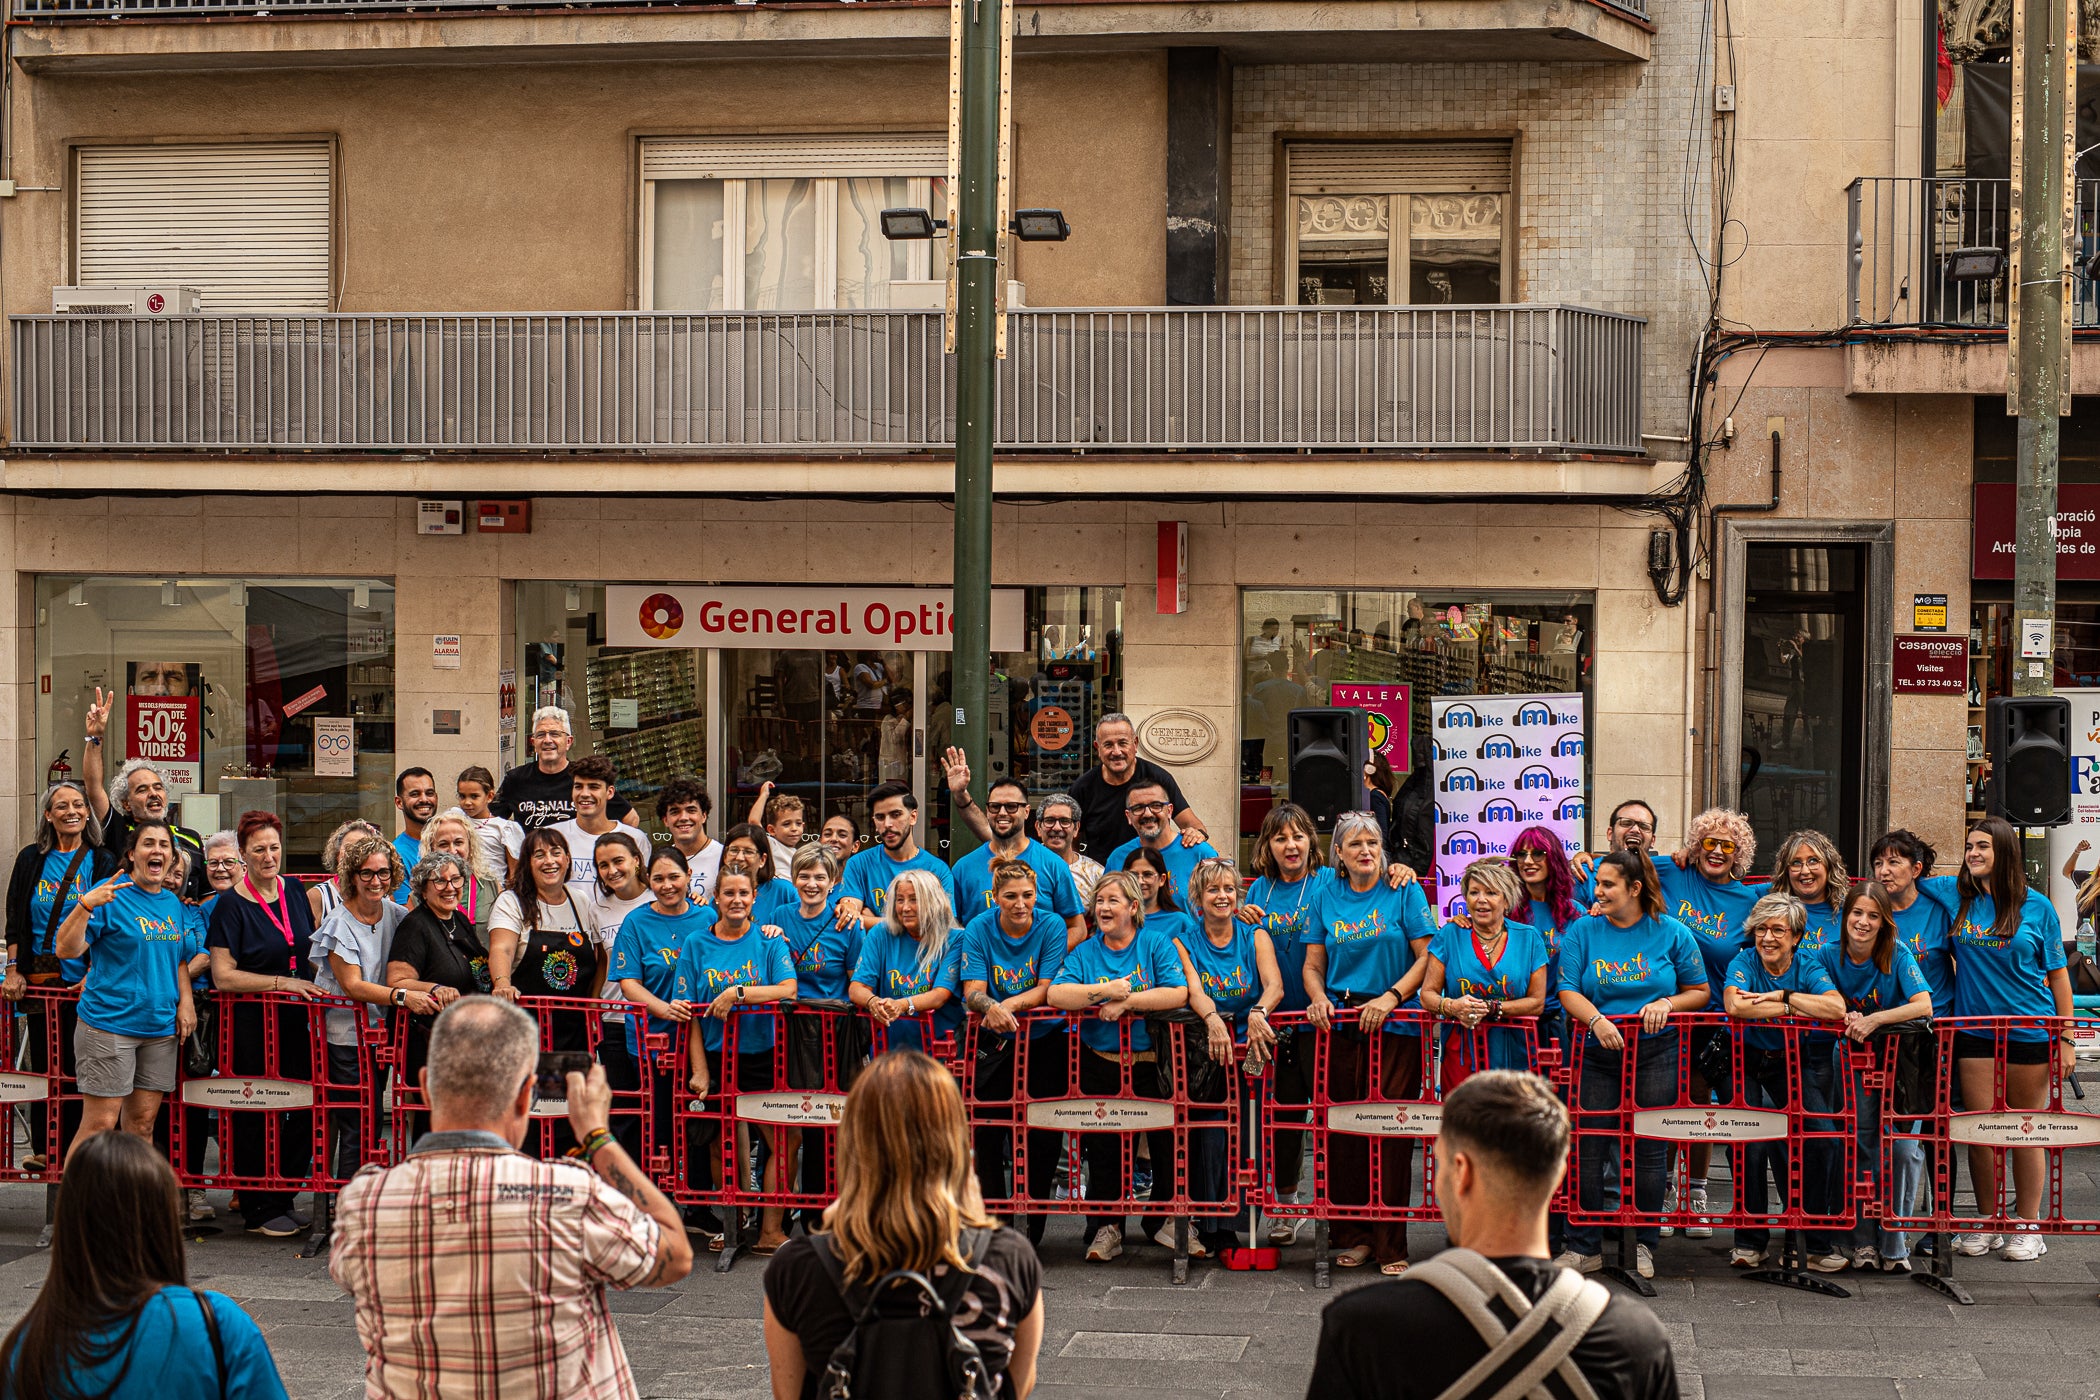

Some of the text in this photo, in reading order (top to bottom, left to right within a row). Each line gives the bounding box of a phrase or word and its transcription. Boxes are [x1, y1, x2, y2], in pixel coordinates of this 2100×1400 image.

[2056, 510, 2095, 522] oració
[2080, 542, 2096, 554] de
[700, 601, 954, 643] General Opti
[1899, 641, 1963, 651] casanovas
[1917, 664, 1944, 672] Visites
[1898, 678, 1915, 686] TEL.
[1340, 690, 1403, 701] YALEA
[171, 710, 187, 720] DTE.
[1150, 727, 1206, 738] GENERAL
[1158, 737, 1199, 747] OPTICA
[138, 742, 186, 758] VIDRES
[1676, 916, 1685, 925] al
[1688, 919, 1703, 931] seu
[145, 931, 153, 941] al
[1336, 933, 1345, 944] al
[1347, 931, 1363, 942] seu
[1958, 936, 2011, 950] al seu cap!
[1598, 967, 1652, 985] al seu cap!
[712, 983, 722, 994] al
[1007, 981, 1023, 990] seu
[902, 987, 917, 995] seu
[1212, 989, 1228, 998] seu
[207, 1087, 241, 1096] Ajuntament
[762, 1101, 799, 1109] Ajuntament
[1355, 1113, 1394, 1121] Ajuntament
[1662, 1118, 1702, 1126] Ajuntament
[1977, 1123, 2018, 1131] Ajuntament
